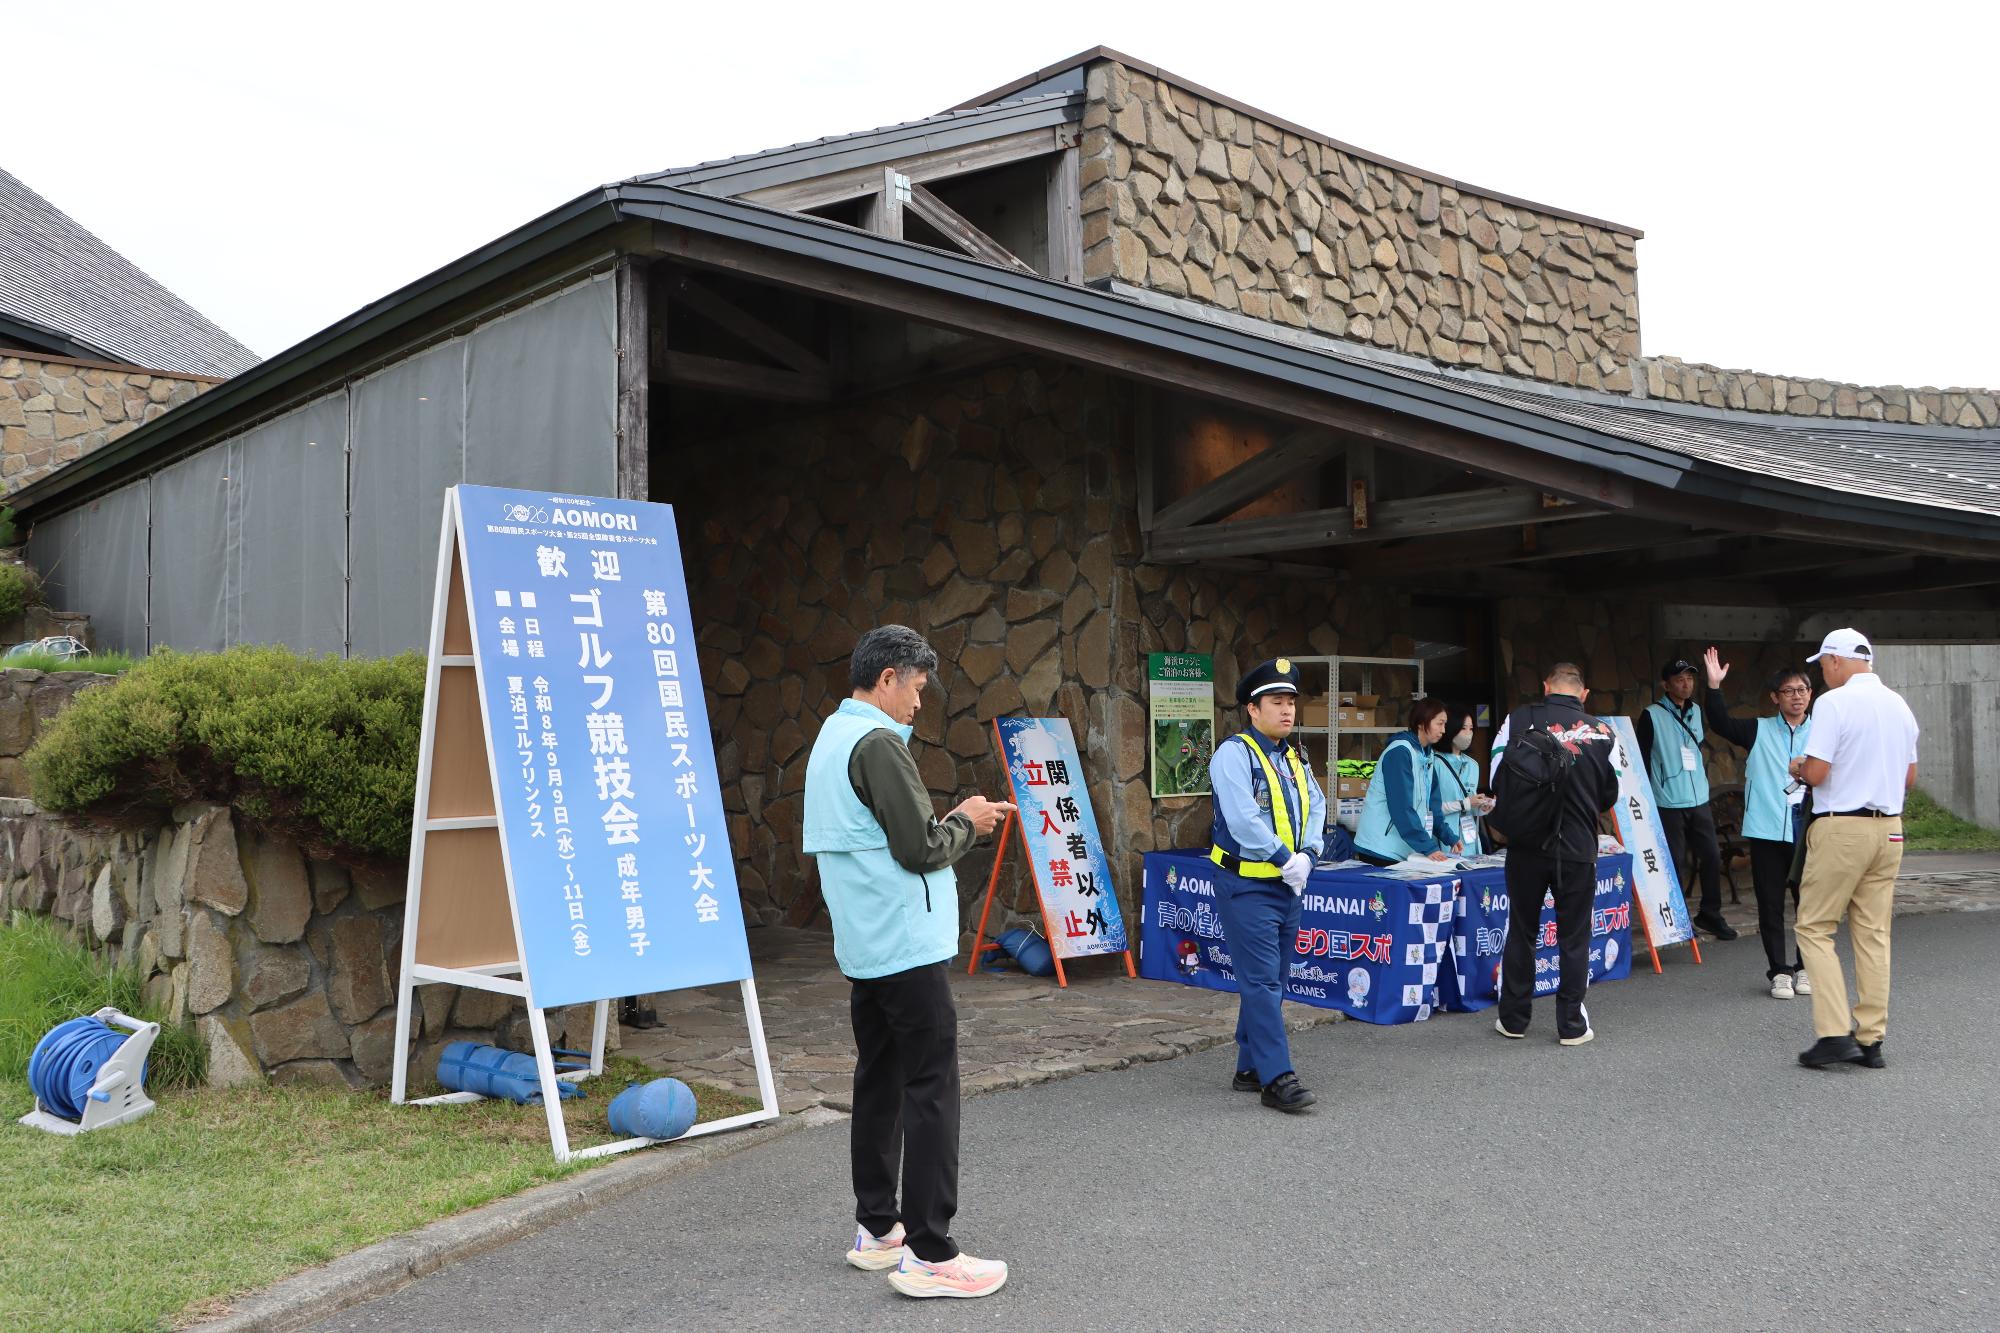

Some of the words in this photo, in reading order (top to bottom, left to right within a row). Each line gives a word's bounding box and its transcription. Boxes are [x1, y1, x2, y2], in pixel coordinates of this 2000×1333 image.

[552, 508, 638, 531] AOMORI
[507, 676, 546, 838] 夏泊ゴルフリンクス
[570, 588, 640, 845] ゴルフ競技会
[616, 853, 651, 957] 成年男子
[642, 589, 720, 923] 第80回国民スポーツ大会
[1023, 759, 1087, 938] 立入禁止
[1045, 759, 1108, 936] 関係者以外
[1292, 984, 1327, 999] GAMES
